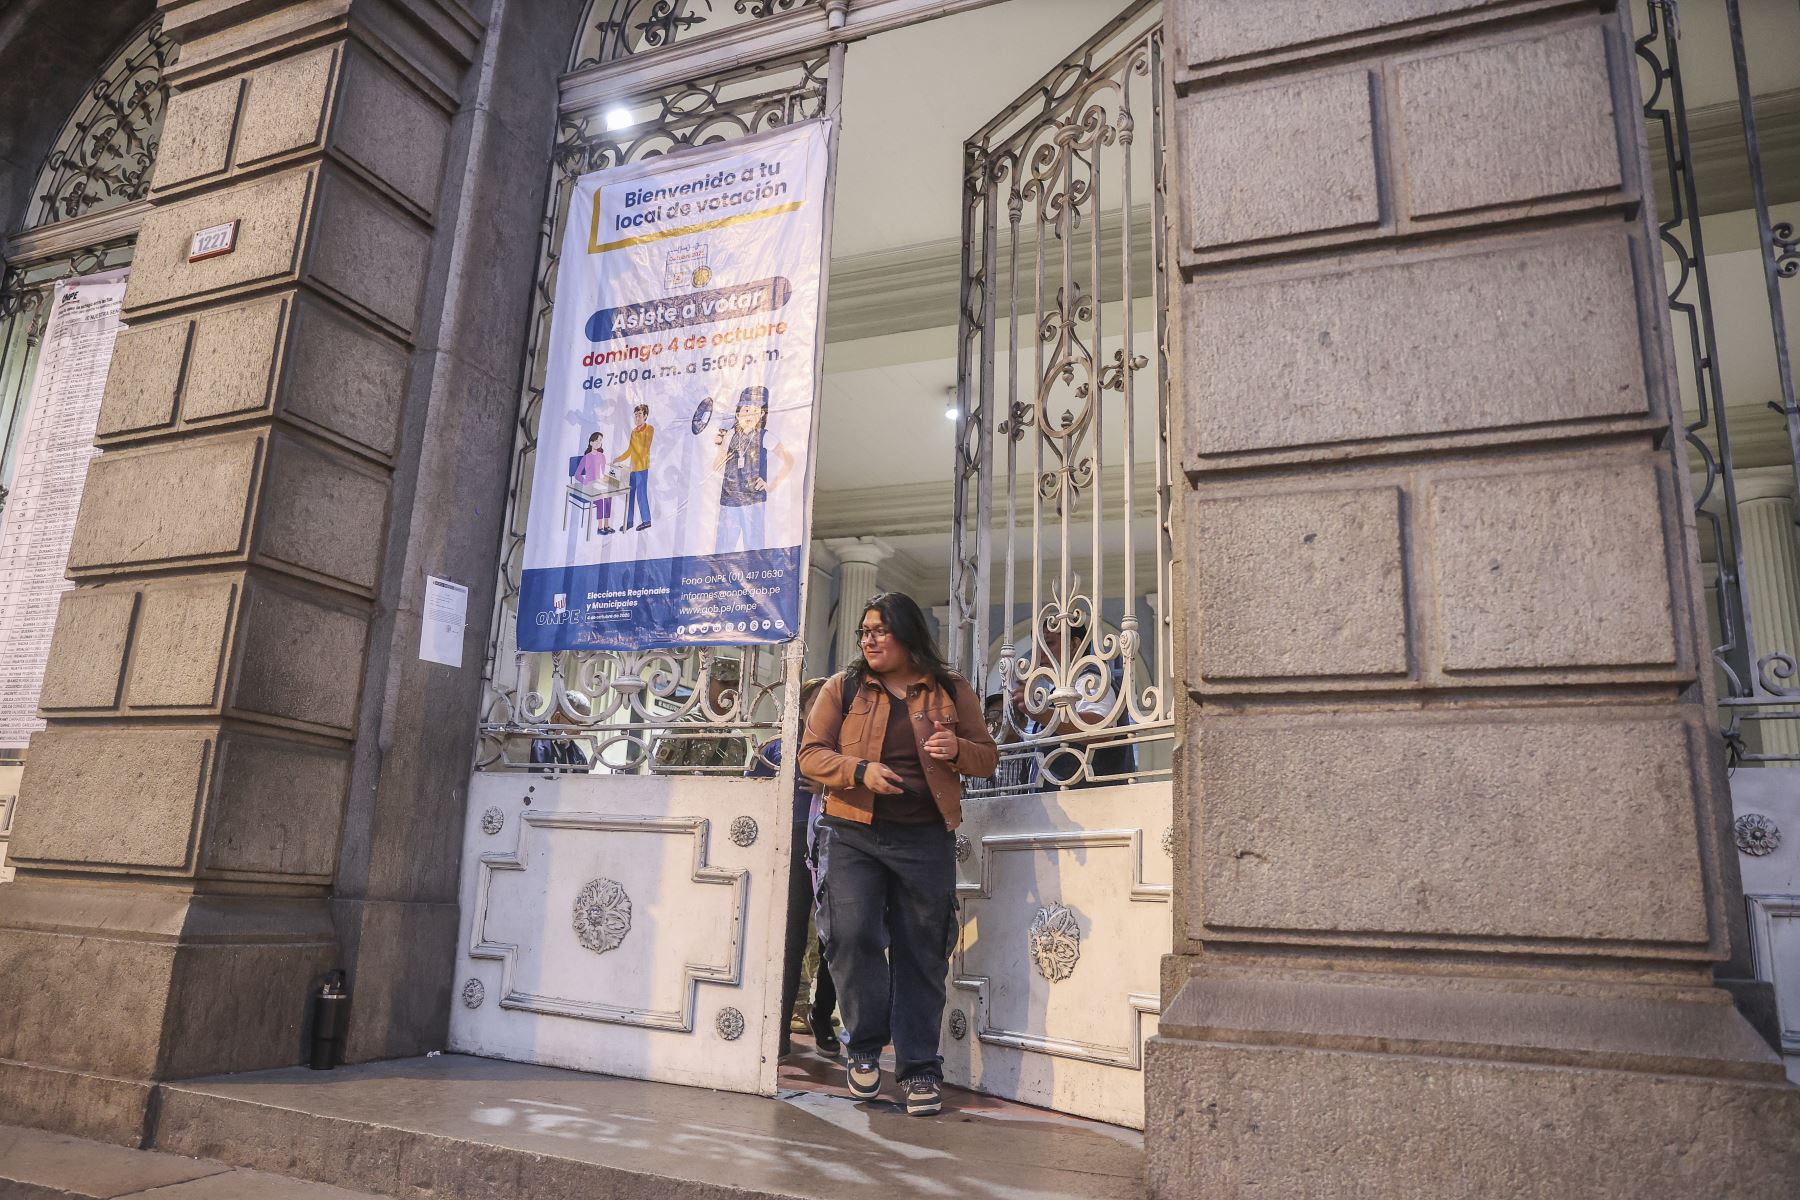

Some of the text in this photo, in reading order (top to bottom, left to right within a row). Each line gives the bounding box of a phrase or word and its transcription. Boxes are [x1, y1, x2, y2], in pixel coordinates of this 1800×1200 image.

[625, 162, 781, 208] Bienvenido a tu
[615, 180, 787, 230] local de votación
[198, 231, 227, 251] 1227
[612, 290, 763, 332] Asiste a votar
[582, 321, 788, 367] domingo 4 de octubre
[582, 348, 784, 391] de 7:00 a. m. a 5:00 p. m.
[681, 569, 784, 585] Fono ONPE (01) 417 0630
[587, 587, 670, 600] Elecciones Regionales
[680, 586, 781, 601] informes@onpe.gob.pe
[586, 600, 638, 611] y Municipales
[680, 602, 757, 615] www.gob.pe/onpe
[536, 609, 581, 625] ONPE
